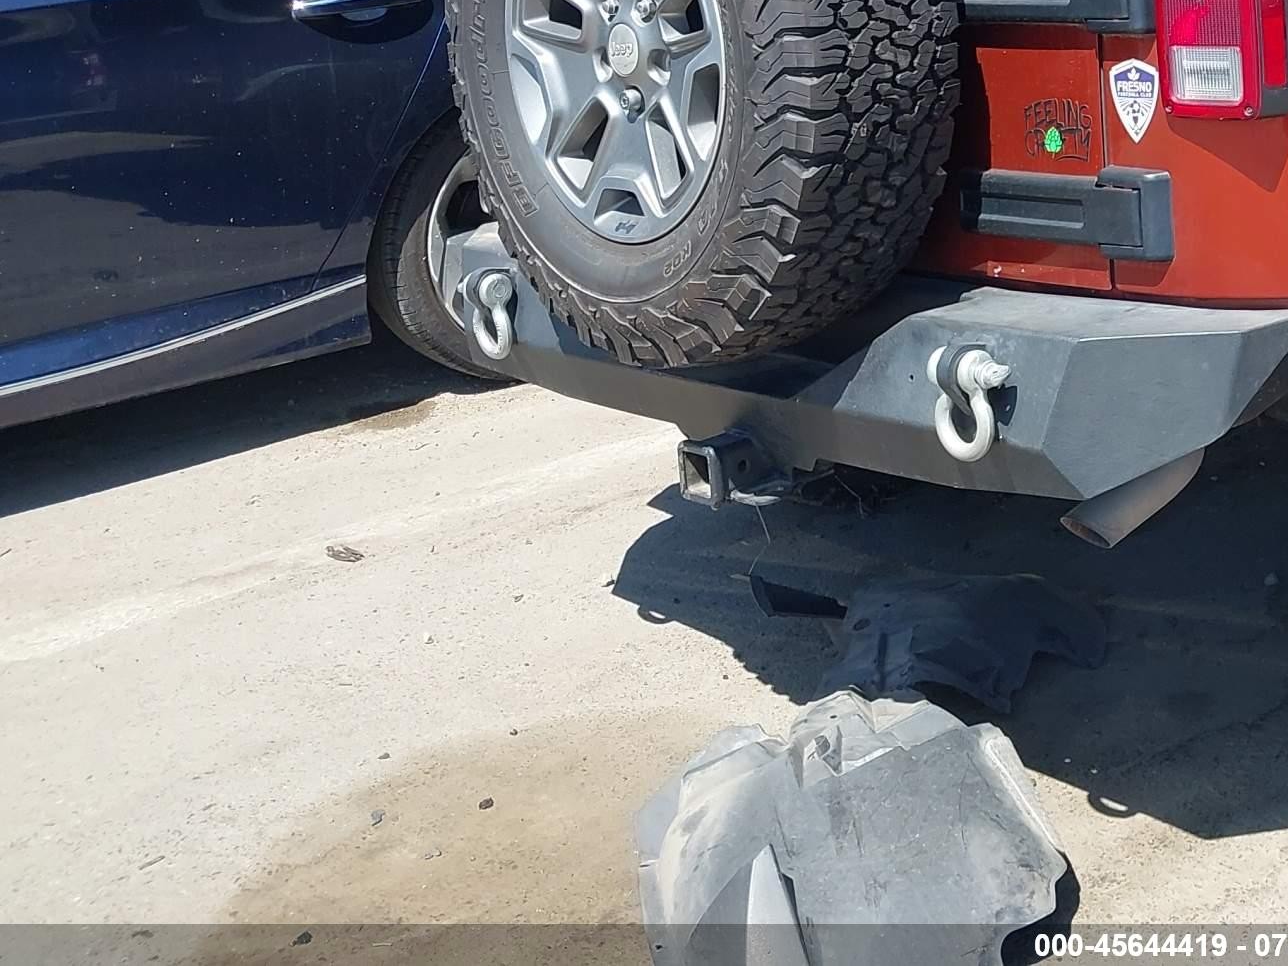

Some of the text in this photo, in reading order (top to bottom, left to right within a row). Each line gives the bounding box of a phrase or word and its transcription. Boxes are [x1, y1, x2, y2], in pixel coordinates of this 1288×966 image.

[610, 41, 634, 58] Jeep
[1116, 81, 1153, 93] FRESNO
[1023, 97, 1093, 132] FEELING
